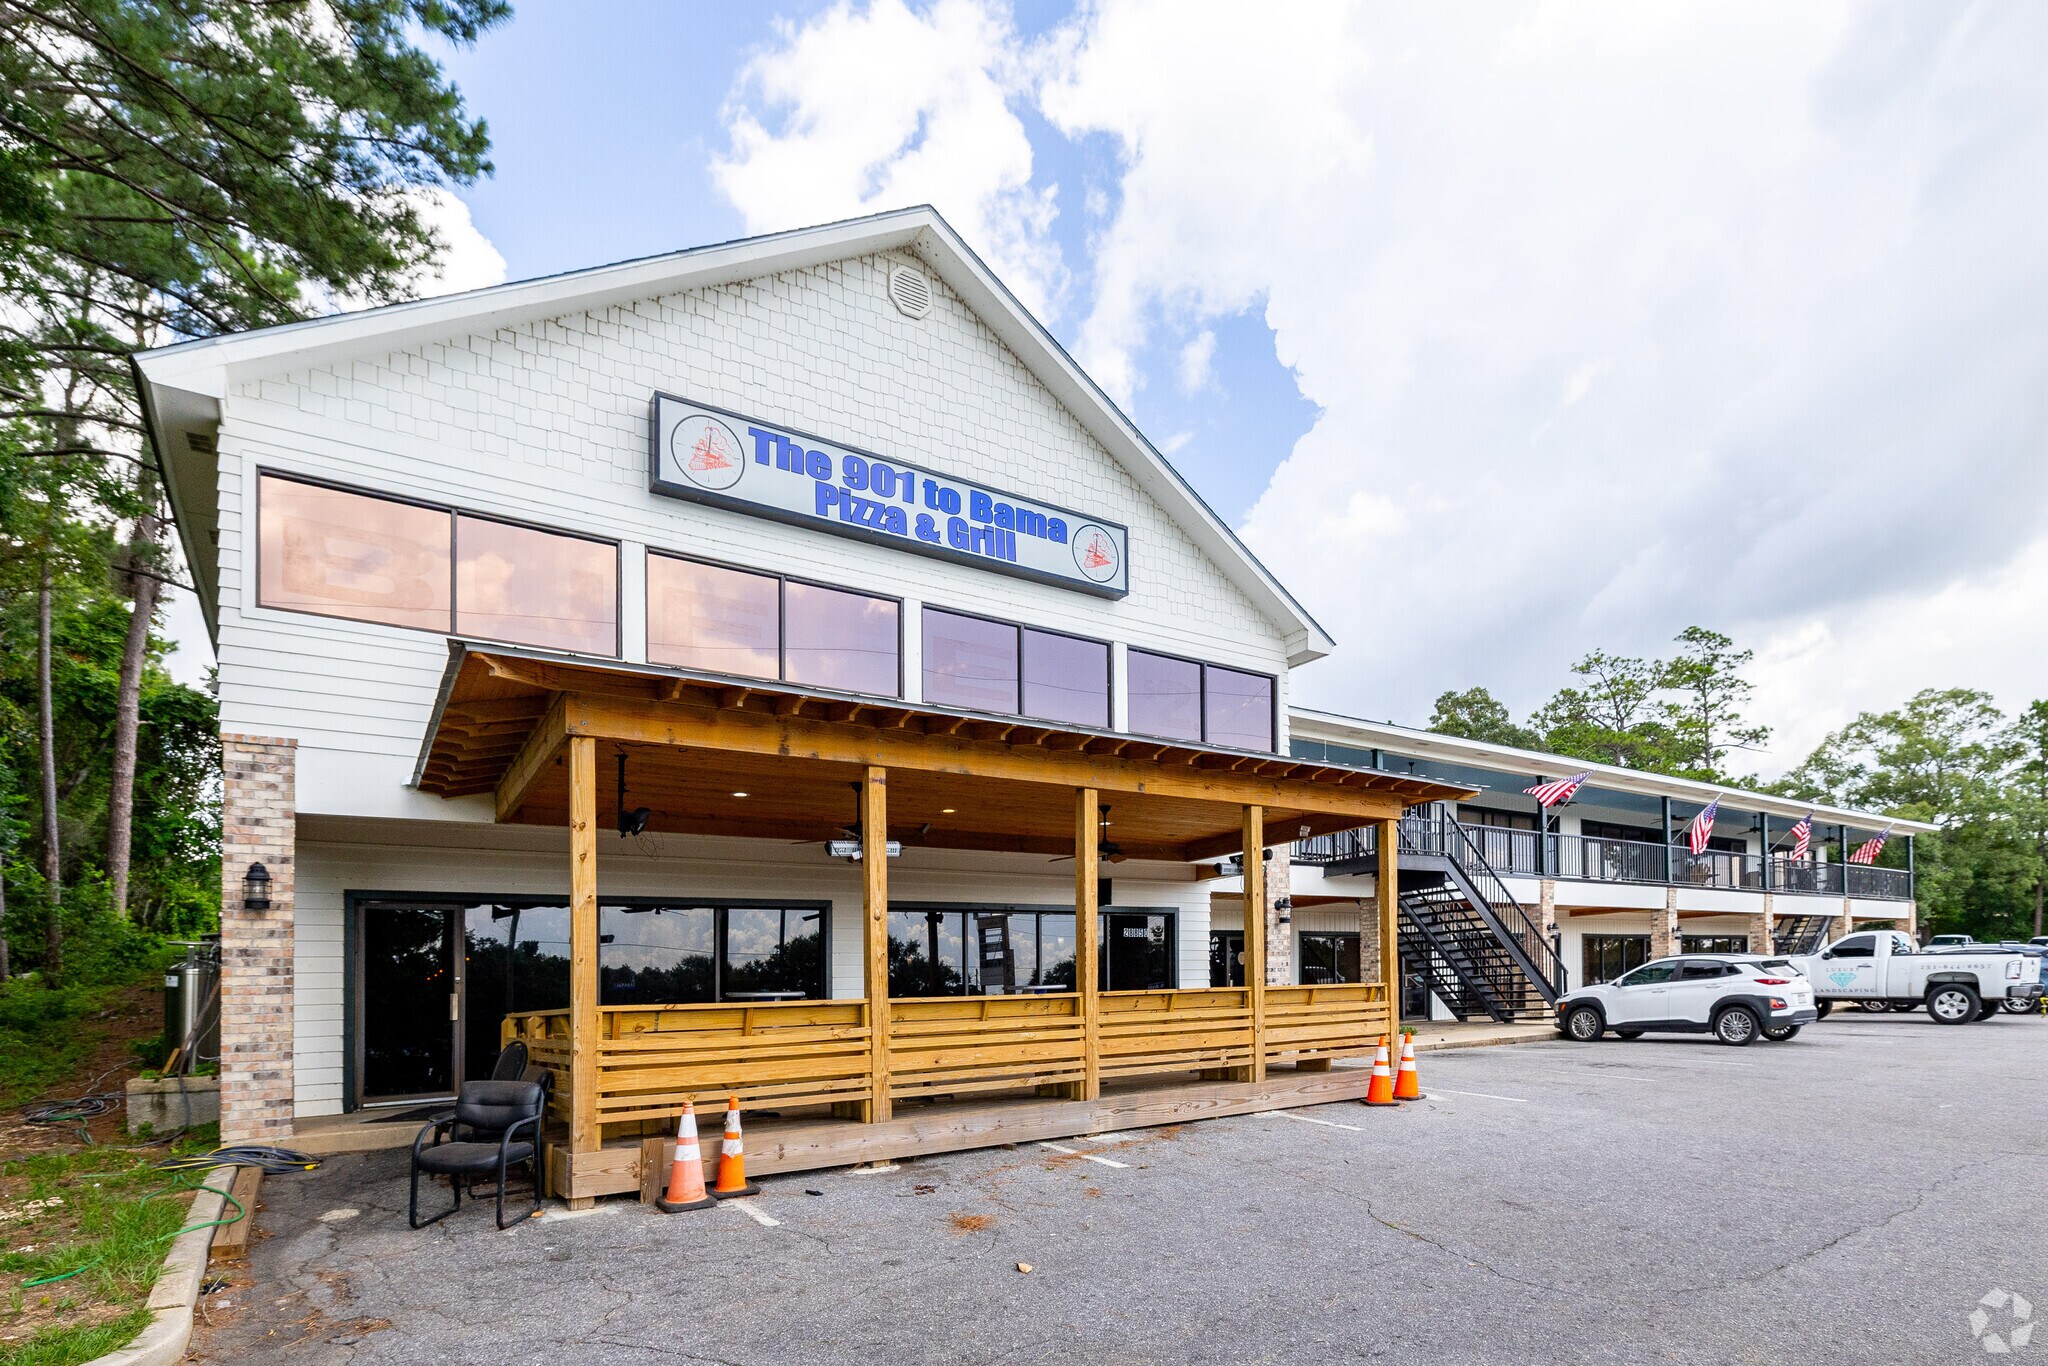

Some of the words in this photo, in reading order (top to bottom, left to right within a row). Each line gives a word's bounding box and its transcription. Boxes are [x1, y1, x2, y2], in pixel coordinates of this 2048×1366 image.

[748, 426, 832, 480] The
[842, 455, 915, 504] 901
[922, 478, 961, 515] to
[970, 489, 1067, 544] Bama
[815, 480, 908, 536] Pizza
[915, 513, 941, 544] &
[947, 516, 1016, 562] Grill
